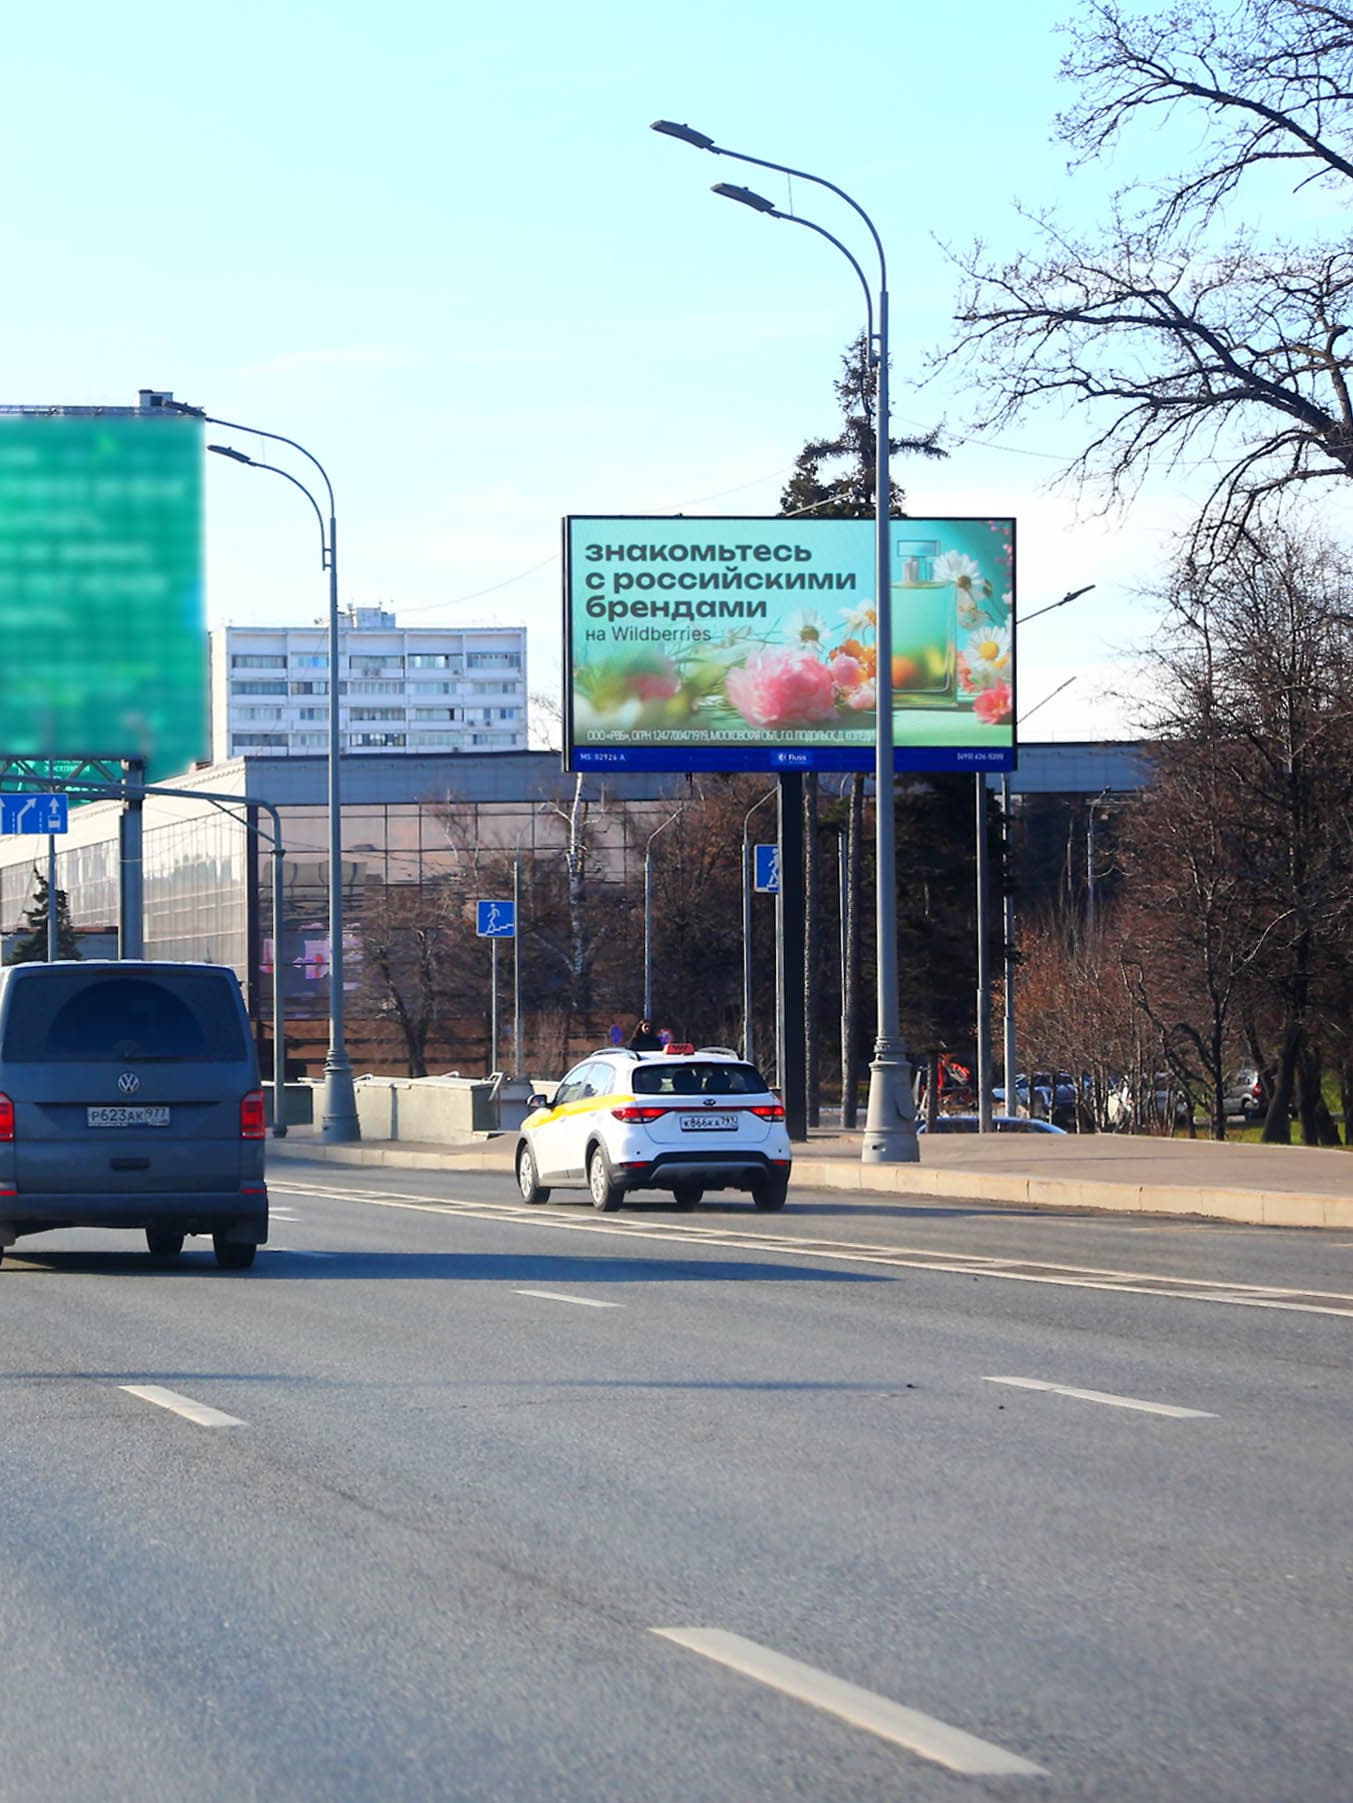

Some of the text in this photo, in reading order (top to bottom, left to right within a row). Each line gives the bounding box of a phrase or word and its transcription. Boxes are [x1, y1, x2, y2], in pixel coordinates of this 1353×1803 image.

[585, 543, 812, 562] знакомьтесь
[585, 565, 857, 594] с российскими
[585, 595, 767, 622] брендами
[585, 626, 712, 642] на Wildberries
